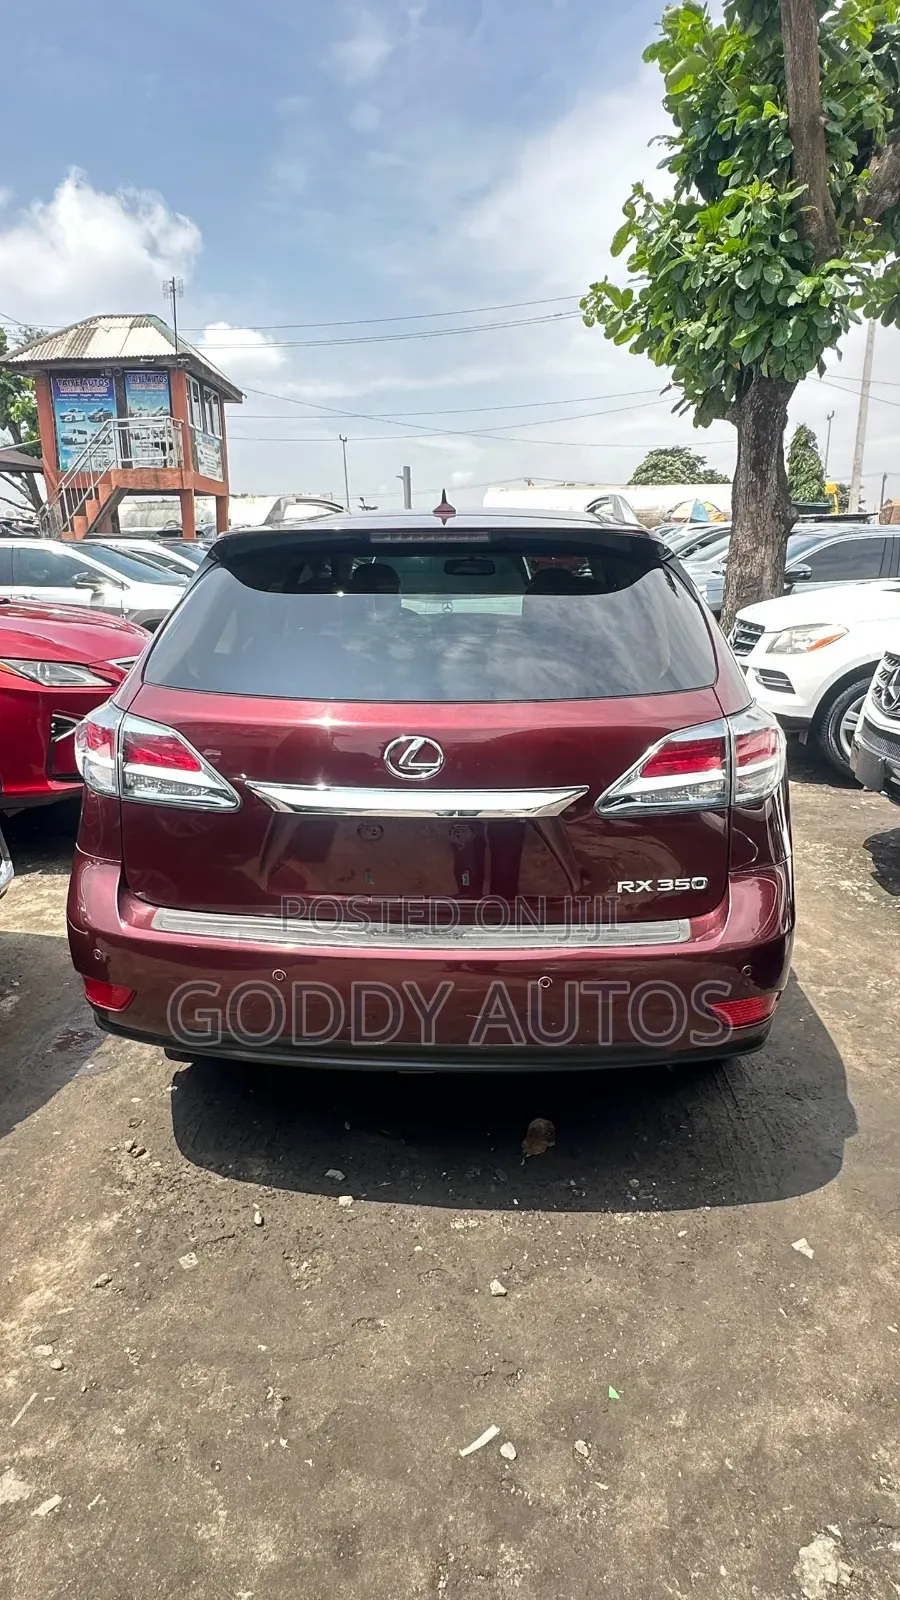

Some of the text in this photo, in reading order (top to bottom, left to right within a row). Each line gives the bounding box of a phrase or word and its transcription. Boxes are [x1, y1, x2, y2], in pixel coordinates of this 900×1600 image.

[56, 378, 110, 387] TAIYE AUTOS
[147, 374, 168, 384] AUTOS
[617, 877, 708, 893] RX 350
